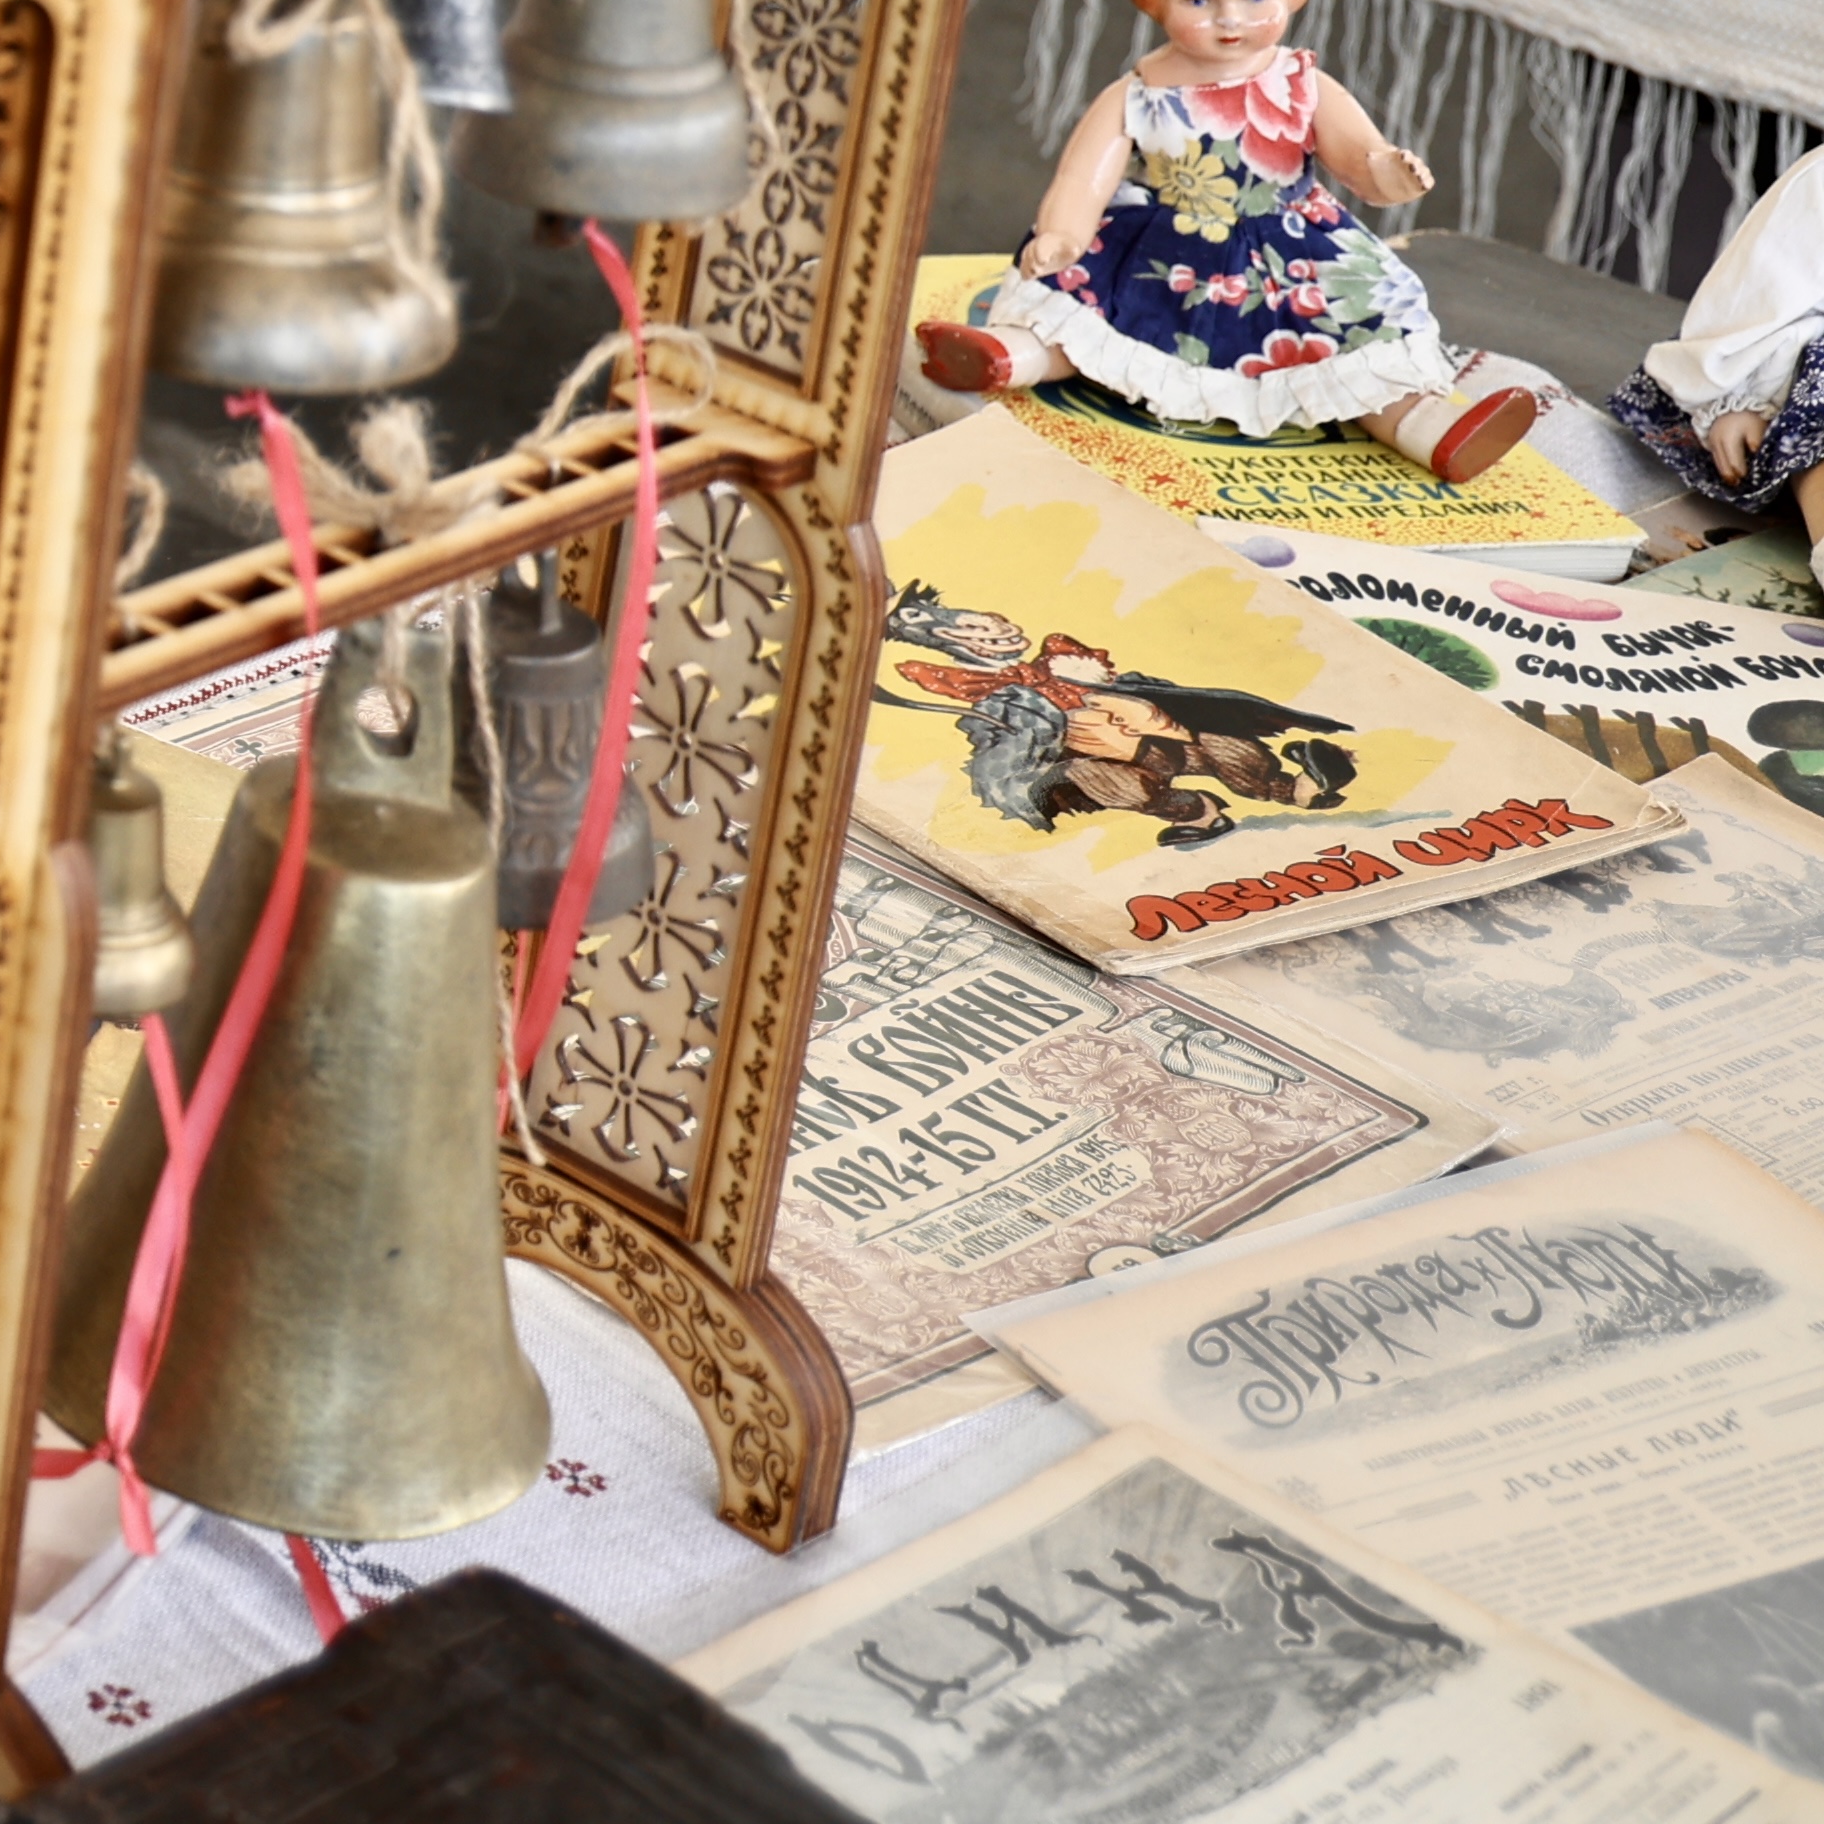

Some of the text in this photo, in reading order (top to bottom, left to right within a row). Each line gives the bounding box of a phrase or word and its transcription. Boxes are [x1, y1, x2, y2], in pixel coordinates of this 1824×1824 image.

[1192, 454, 1402, 471] ЧУКОТСКИЕ
[1211, 466, 1427, 485] НАРОДНЫЕ
[1216, 480, 1479, 506] СКАЗКИ,
[1350, 499, 1532, 521] ПРЕДАНИЯ
